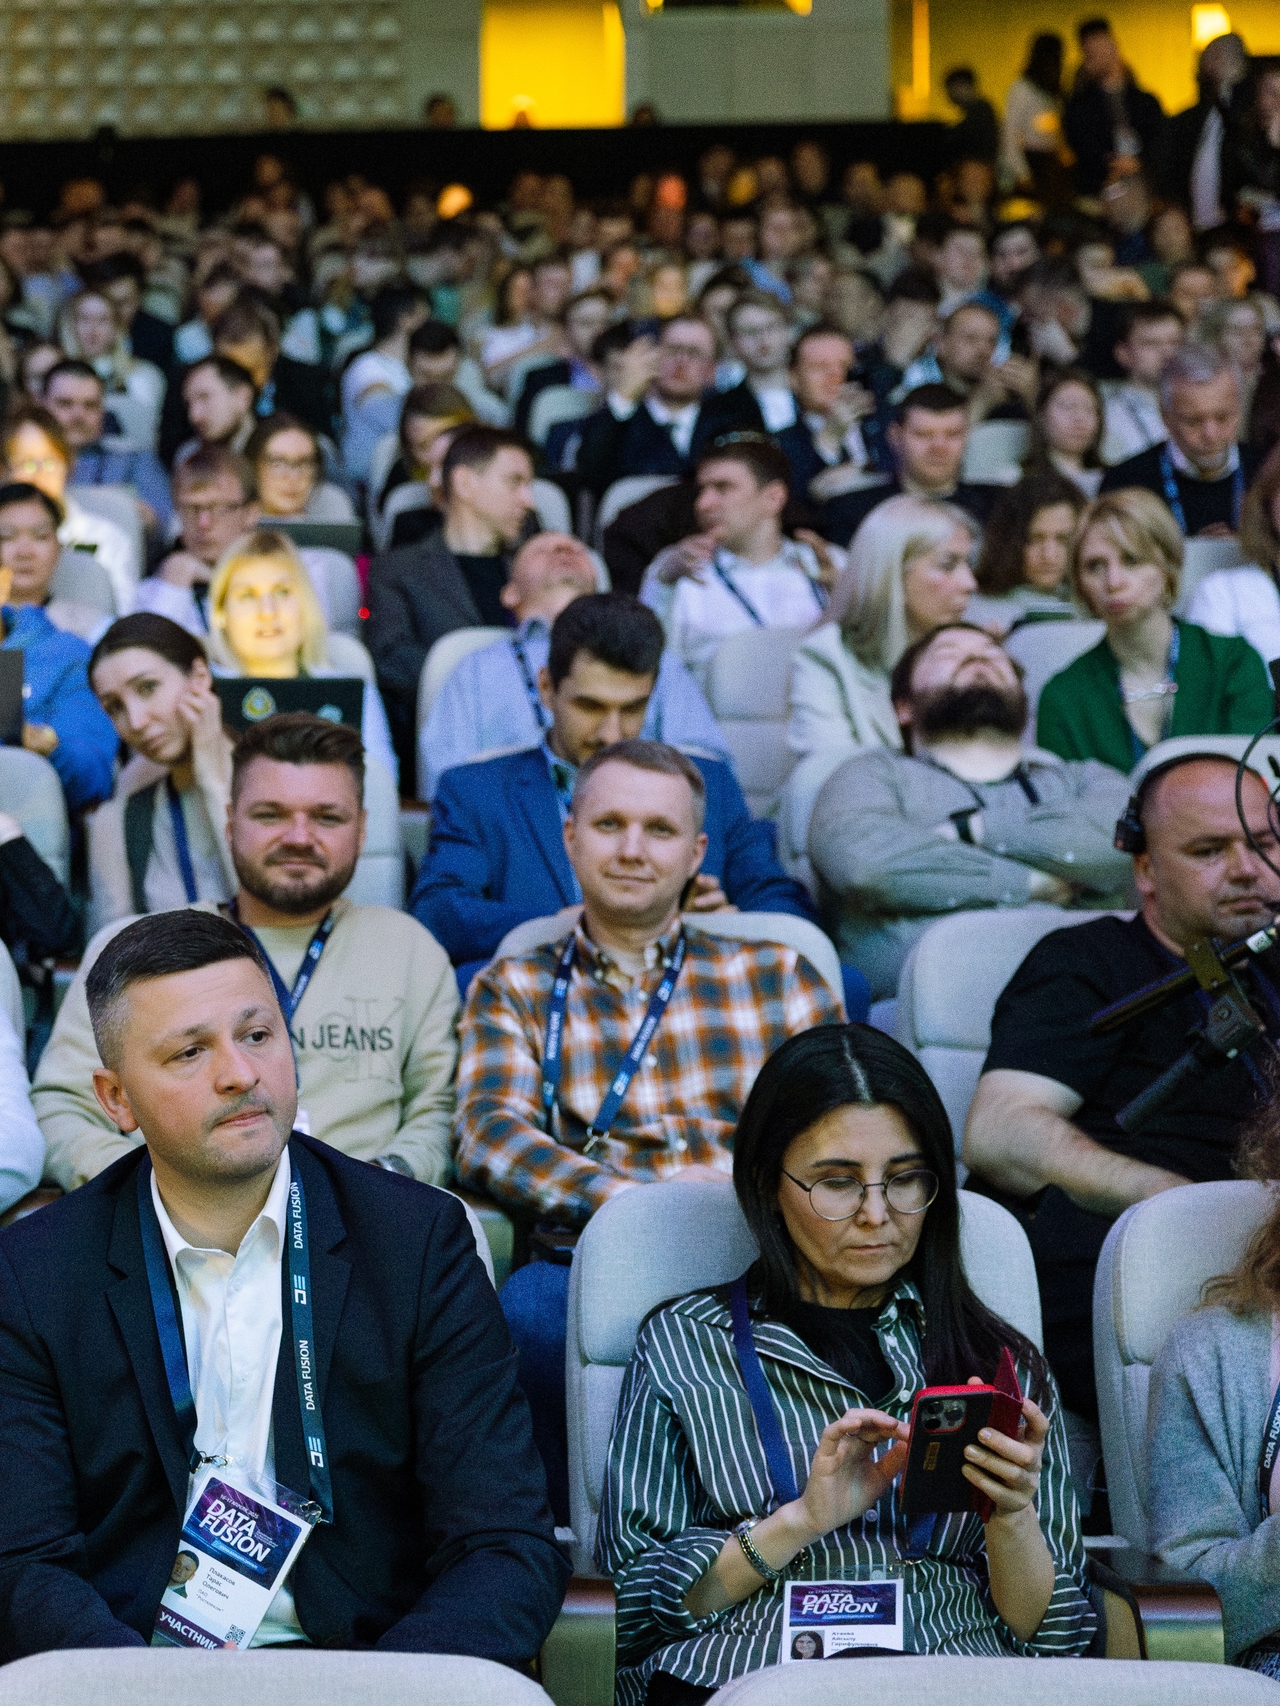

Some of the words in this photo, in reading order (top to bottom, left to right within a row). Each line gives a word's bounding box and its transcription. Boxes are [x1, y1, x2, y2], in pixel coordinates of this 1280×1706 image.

[312, 1024, 394, 1051] JEANS
[290, 1181, 302, 1218] FUSION
[294, 1220, 304, 1249] DATA
[299, 1340, 312, 1380] FUSION
[304, 1381, 316, 1411] DATA
[1263, 1441, 1277, 1469] DATA
[206, 1499, 256, 1537] DATA
[198, 1514, 271, 1562] FUSION
[202, 1580, 230, 1600] Олегович
[205, 1573, 223, 1587] Тарас
[802, 1594, 854, 1604] DATA
[802, 1603, 877, 1614] FUSION
[160, 1611, 218, 1650] УЧАСТНИК
